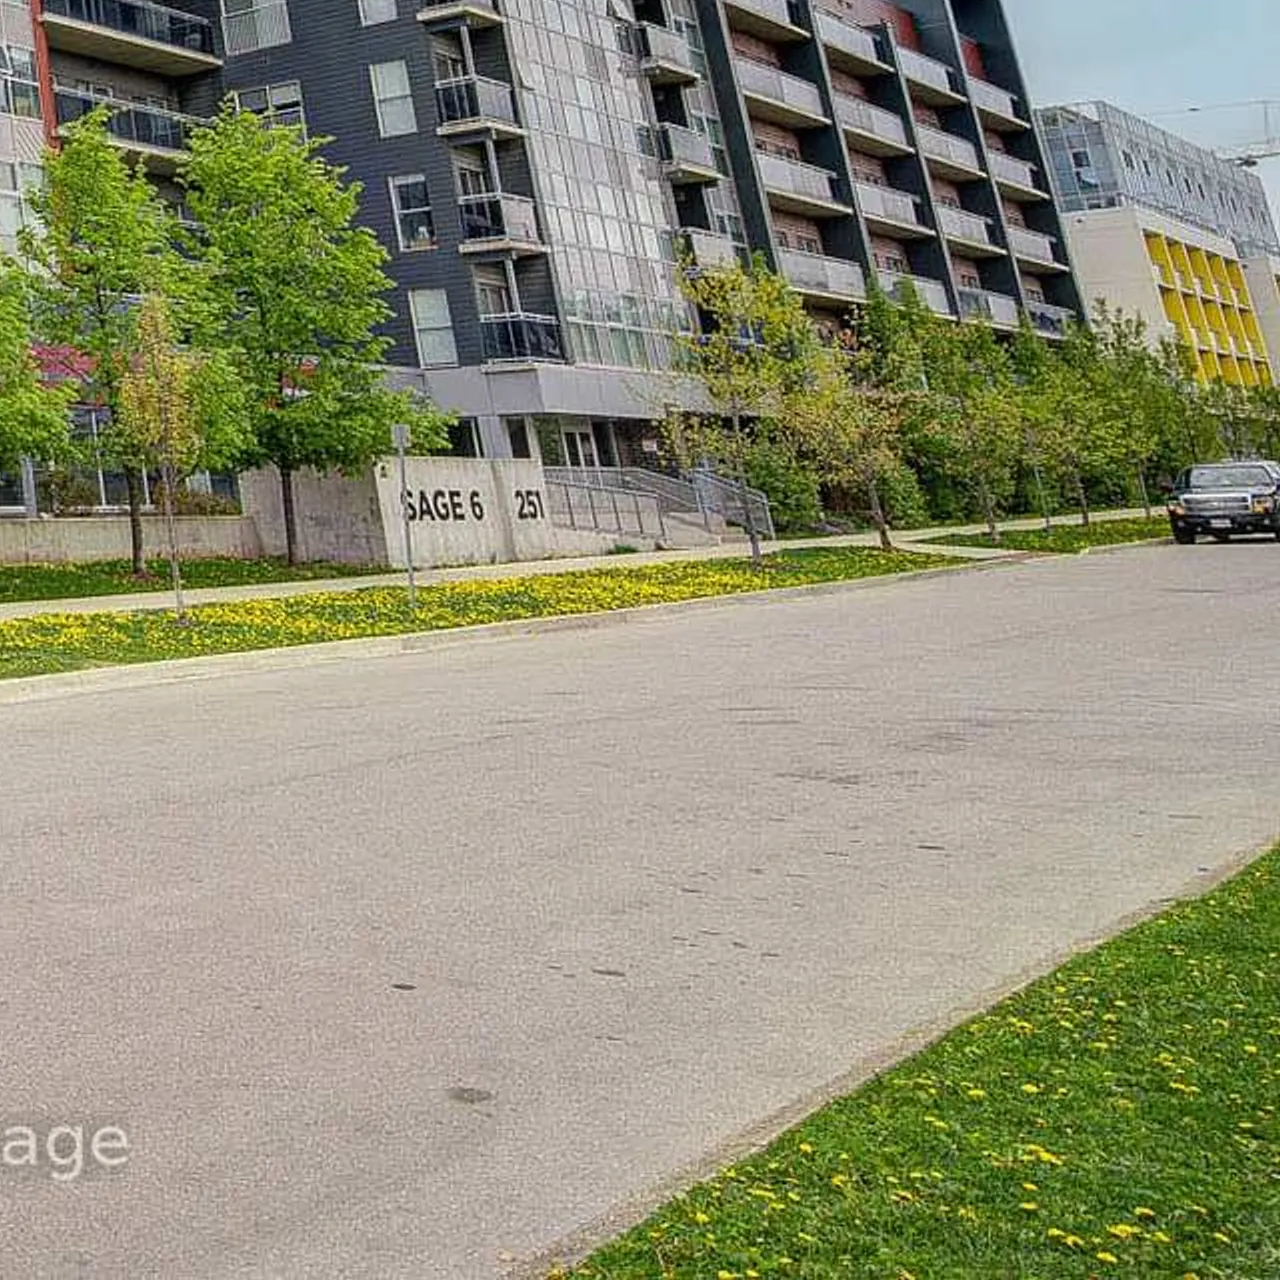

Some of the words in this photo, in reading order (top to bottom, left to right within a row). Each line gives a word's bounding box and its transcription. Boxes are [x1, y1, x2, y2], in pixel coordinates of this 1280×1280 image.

[403, 488, 465, 521] SAGE
[470, 489, 484, 521] 6
[514, 488, 545, 520] 251
